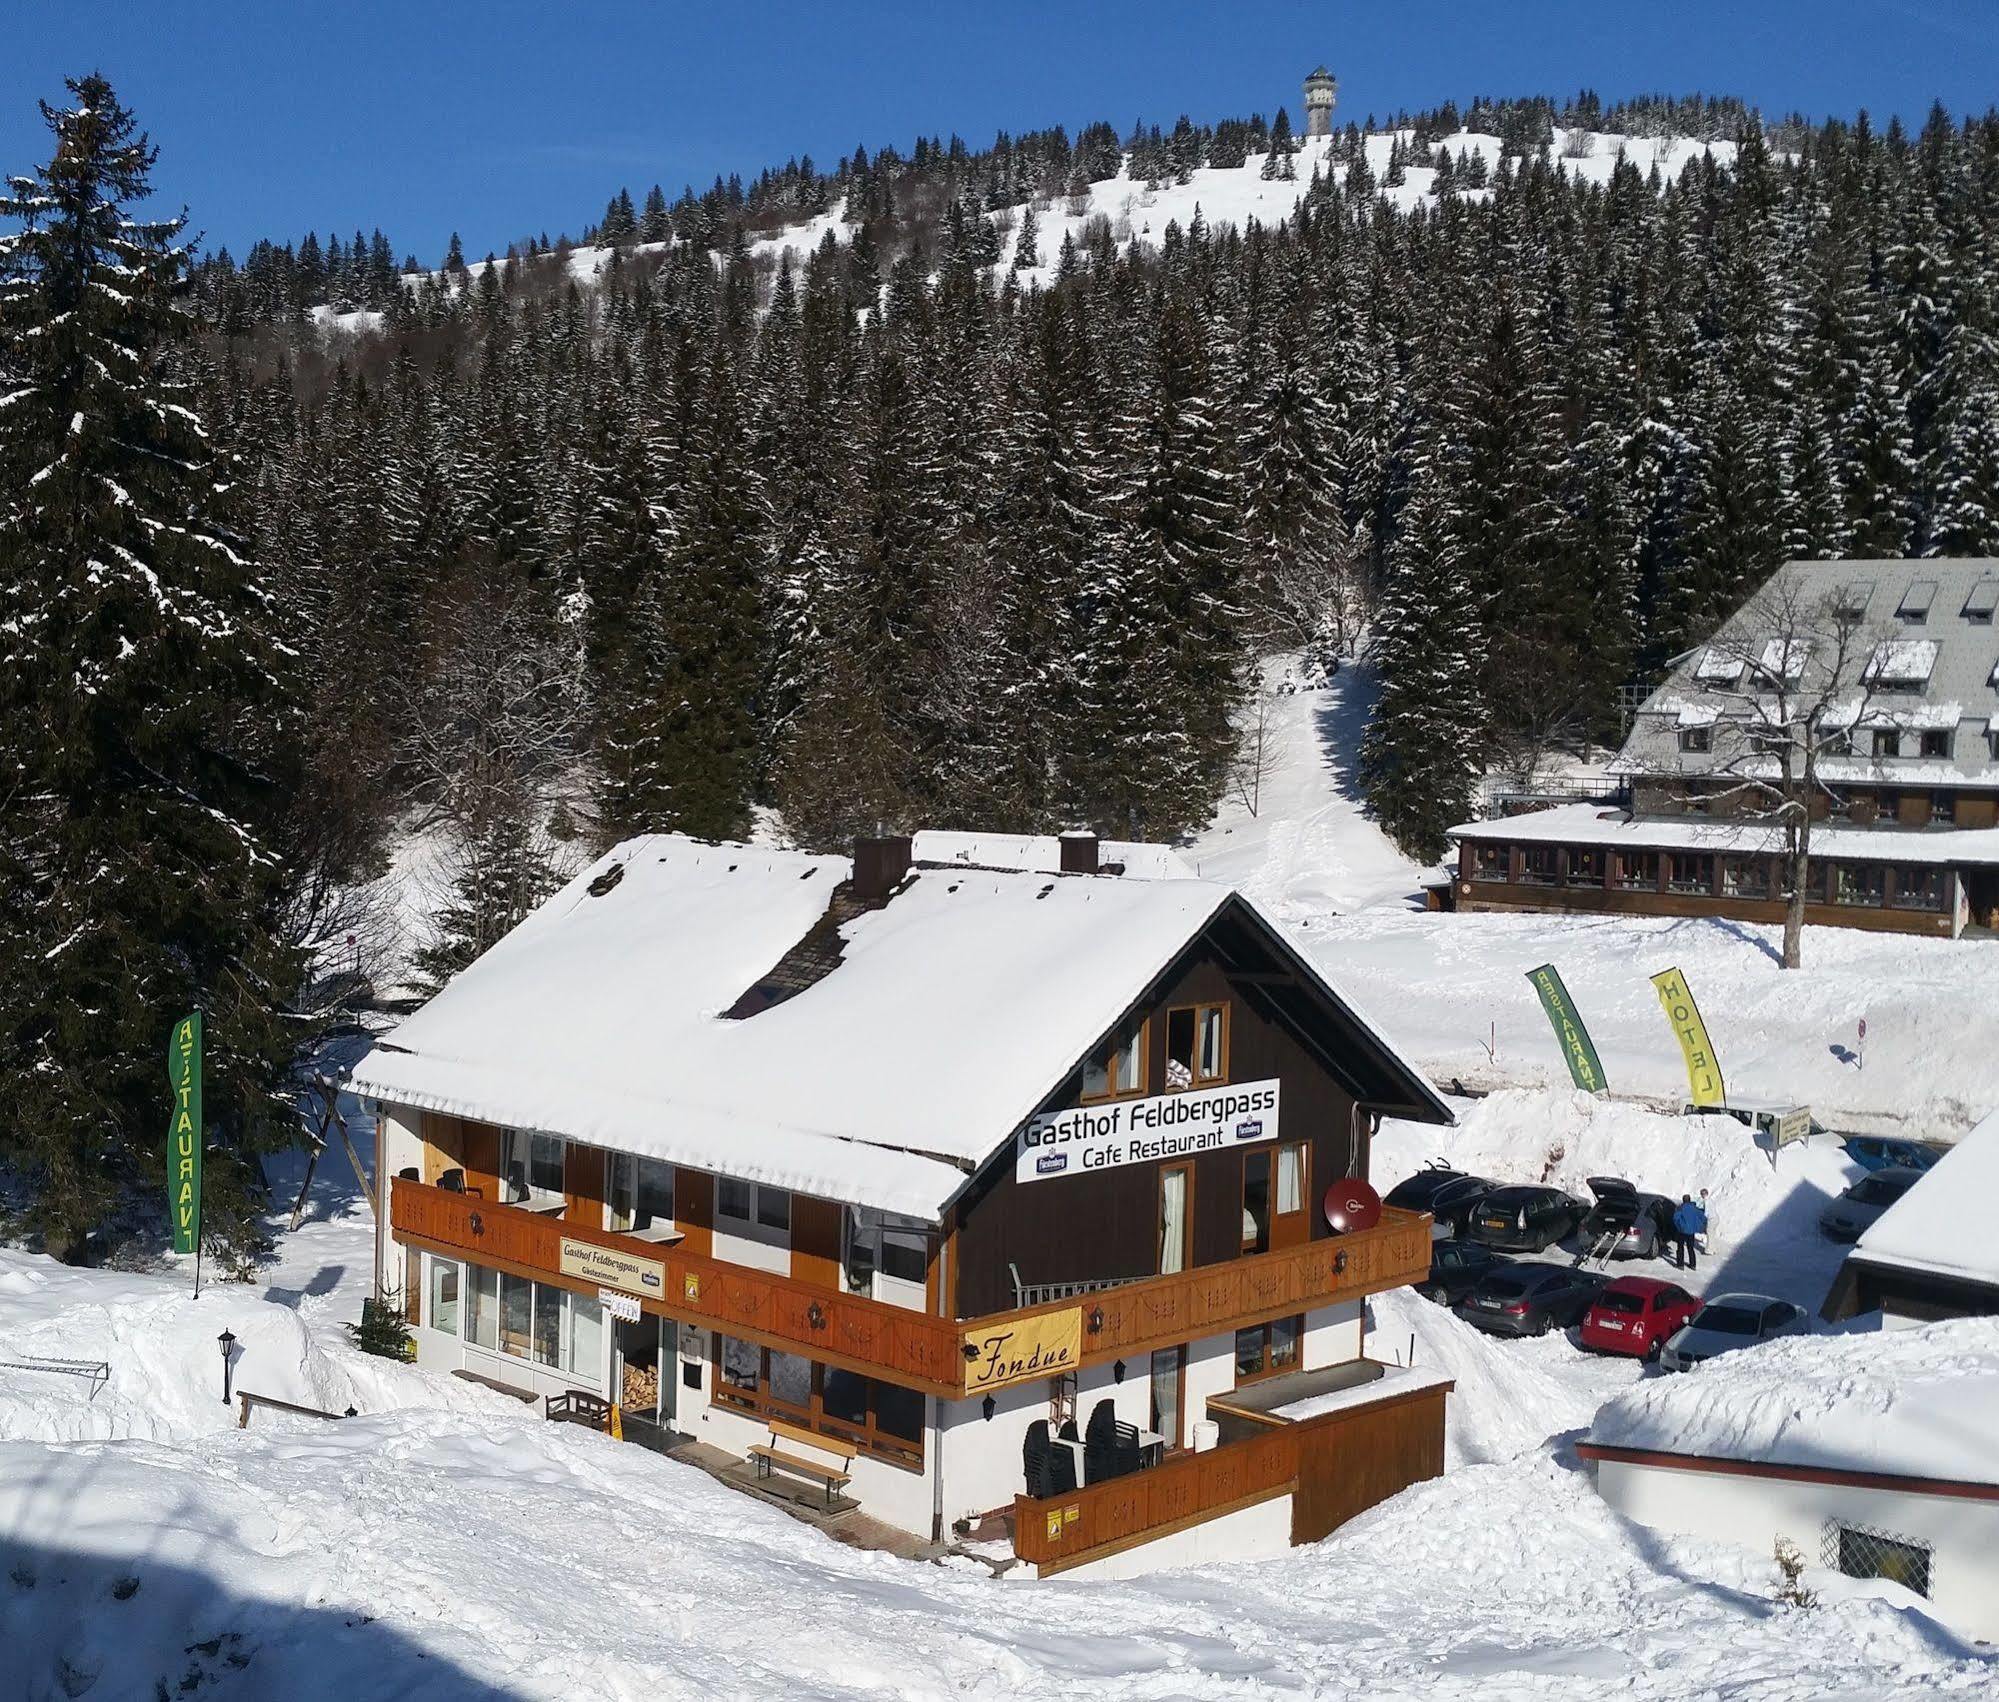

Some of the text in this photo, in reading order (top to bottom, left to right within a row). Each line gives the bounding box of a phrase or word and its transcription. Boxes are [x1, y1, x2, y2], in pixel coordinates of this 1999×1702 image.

[1024, 1090, 1275, 1147] Gasthof Feldbergpass
[1082, 1142, 1122, 1168] Cafe
[1129, 1127, 1224, 1161] Restaurant
[564, 1244, 640, 1273] Gasthof Feldbergpass
[611, 1299, 639, 1318] OFFEN
[977, 1332, 1069, 1381] Fondue
